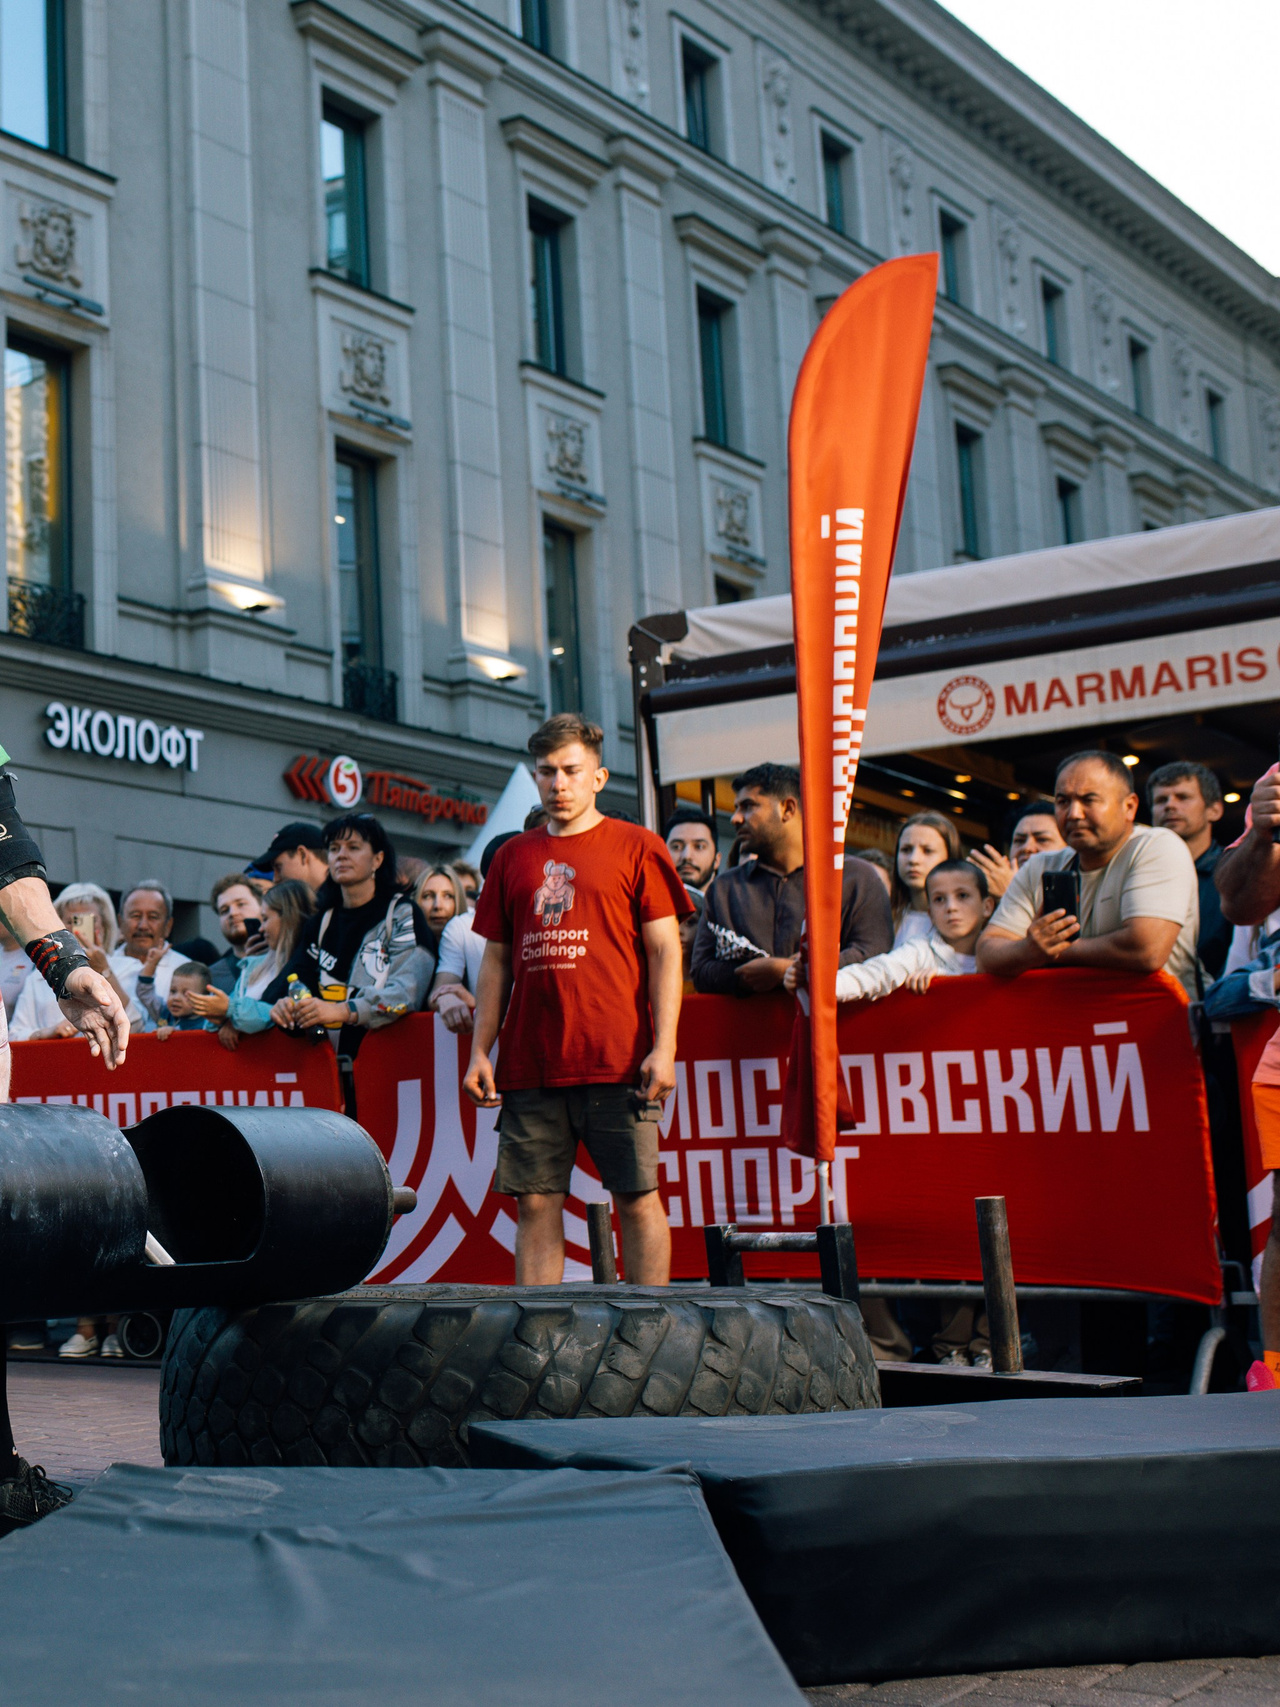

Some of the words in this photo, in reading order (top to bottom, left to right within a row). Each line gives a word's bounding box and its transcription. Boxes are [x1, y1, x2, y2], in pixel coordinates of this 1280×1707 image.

[1004, 647, 1267, 717] MARMARIS
[46, 701, 204, 772] ЭКОЛОФТ
[521, 943, 587, 960] Challenge
[522, 928, 589, 946] Ethnosport
[658, 1021, 1150, 1140] МОСОВСКИЙ
